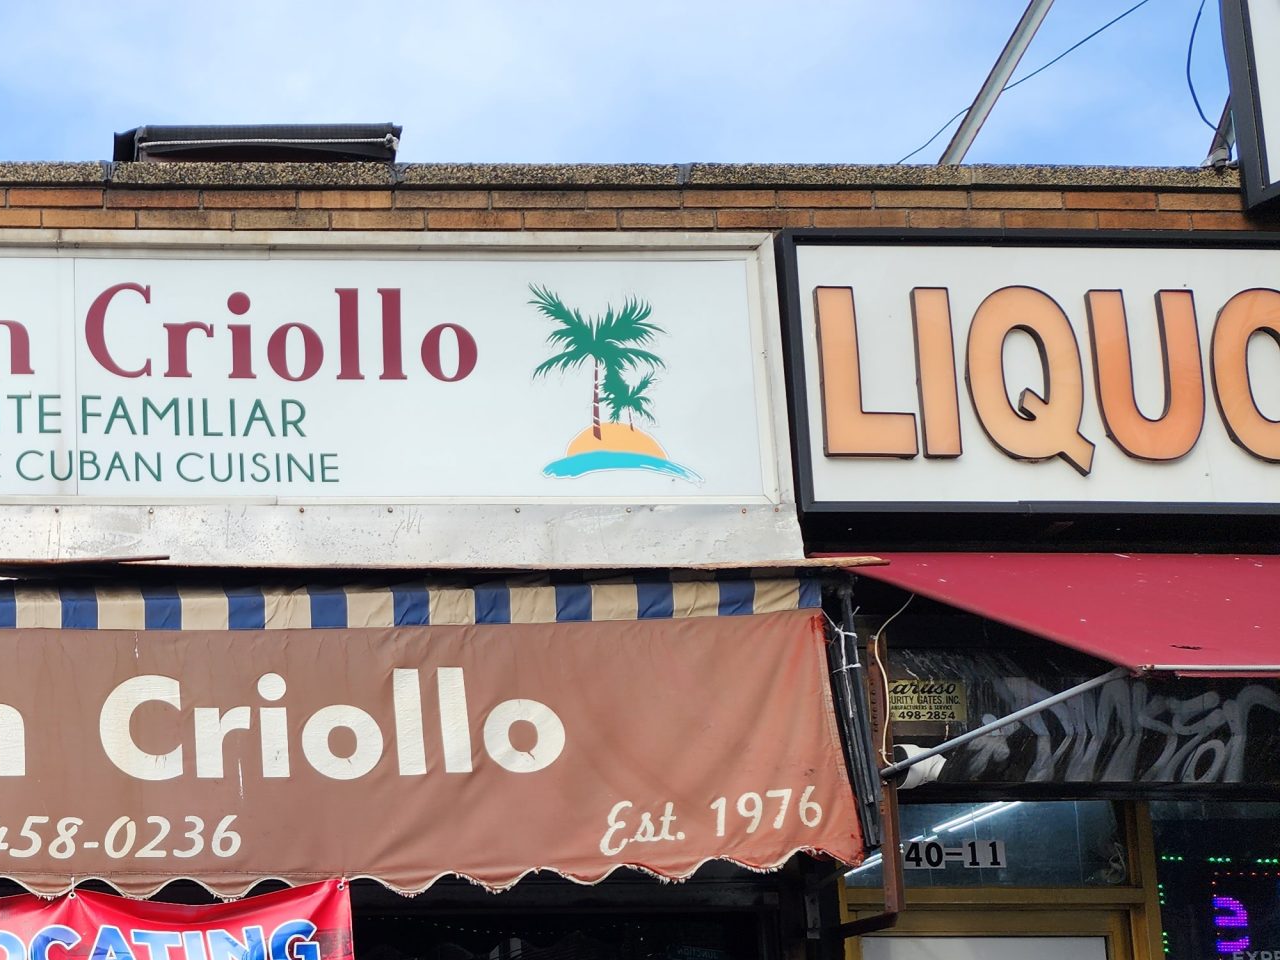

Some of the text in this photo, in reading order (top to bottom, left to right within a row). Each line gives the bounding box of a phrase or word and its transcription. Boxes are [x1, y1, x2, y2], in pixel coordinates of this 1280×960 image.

[84, 282, 478, 382] Criollo
[81, 395, 307, 438] FAMILIAR
[16, 450, 163, 482] CUBAN
[176, 451, 340, 483] CUISINE
[888, 681, 956, 694] aruso
[889, 696, 914, 704] URITY
[99, 666, 566, 782] Criollo
[898, 711, 956, 720] 498-2854
[599, 785, 823, 856] Est. 1976
